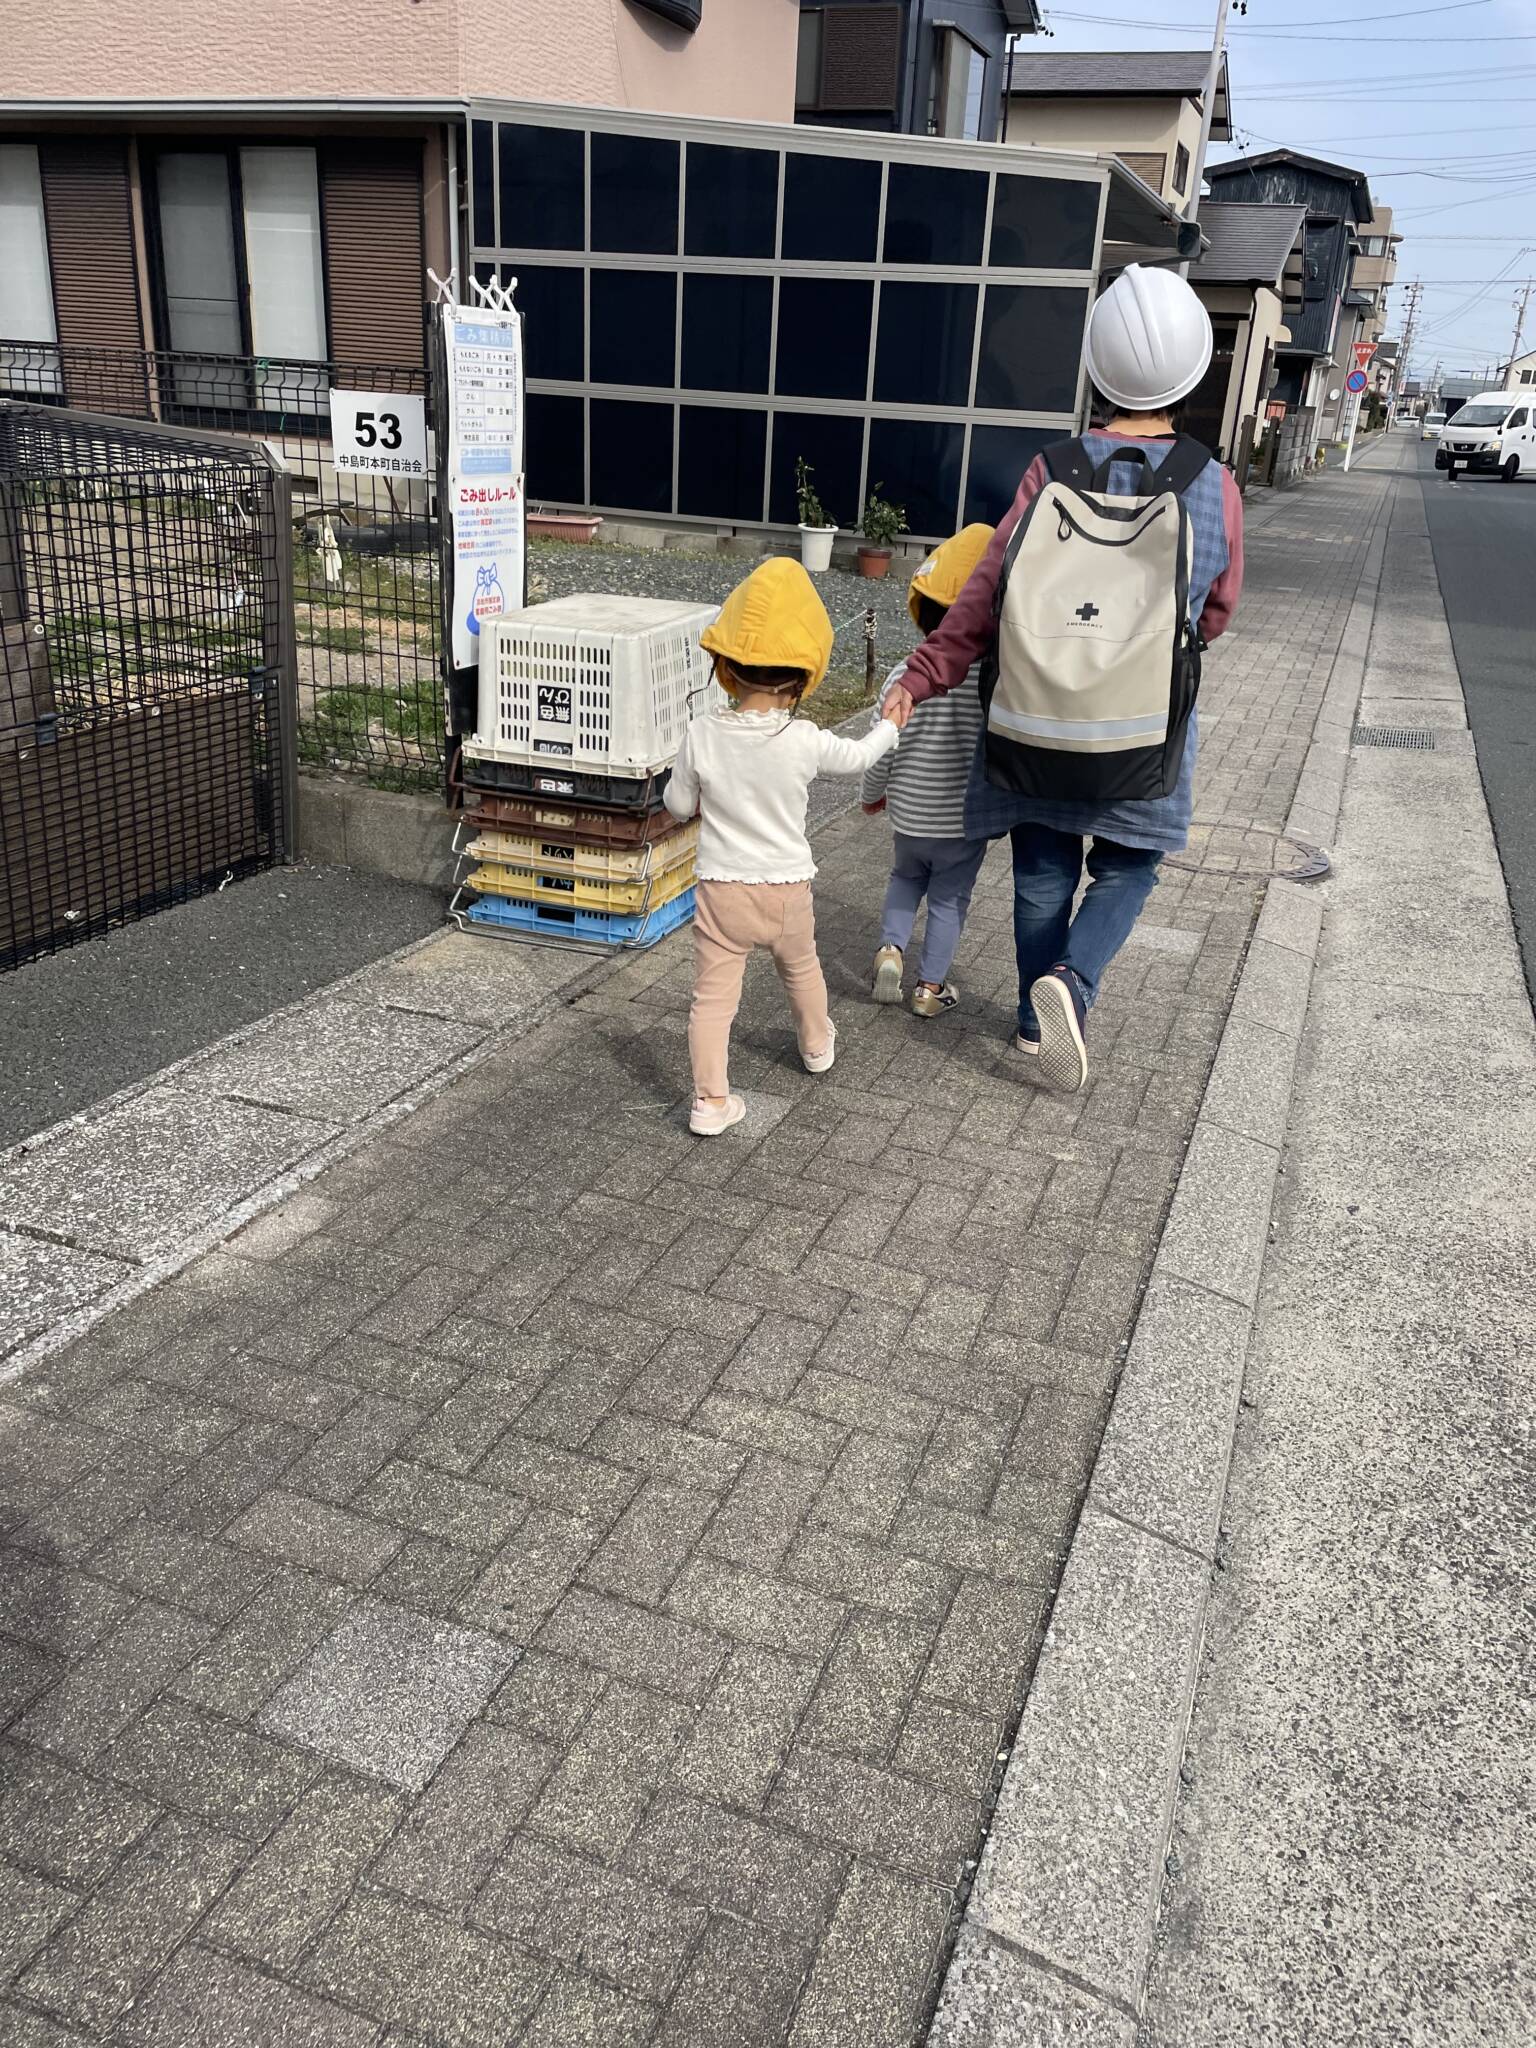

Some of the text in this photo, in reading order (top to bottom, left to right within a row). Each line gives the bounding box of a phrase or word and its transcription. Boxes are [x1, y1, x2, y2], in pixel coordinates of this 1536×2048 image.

[355, 412, 402, 449] 53
[339, 454, 422, 473] 中島町本町自治会
[460, 486, 516, 503] ごみ出しルール
[539, 687, 570, 705] びん
[540, 704, 570, 722] 無色
